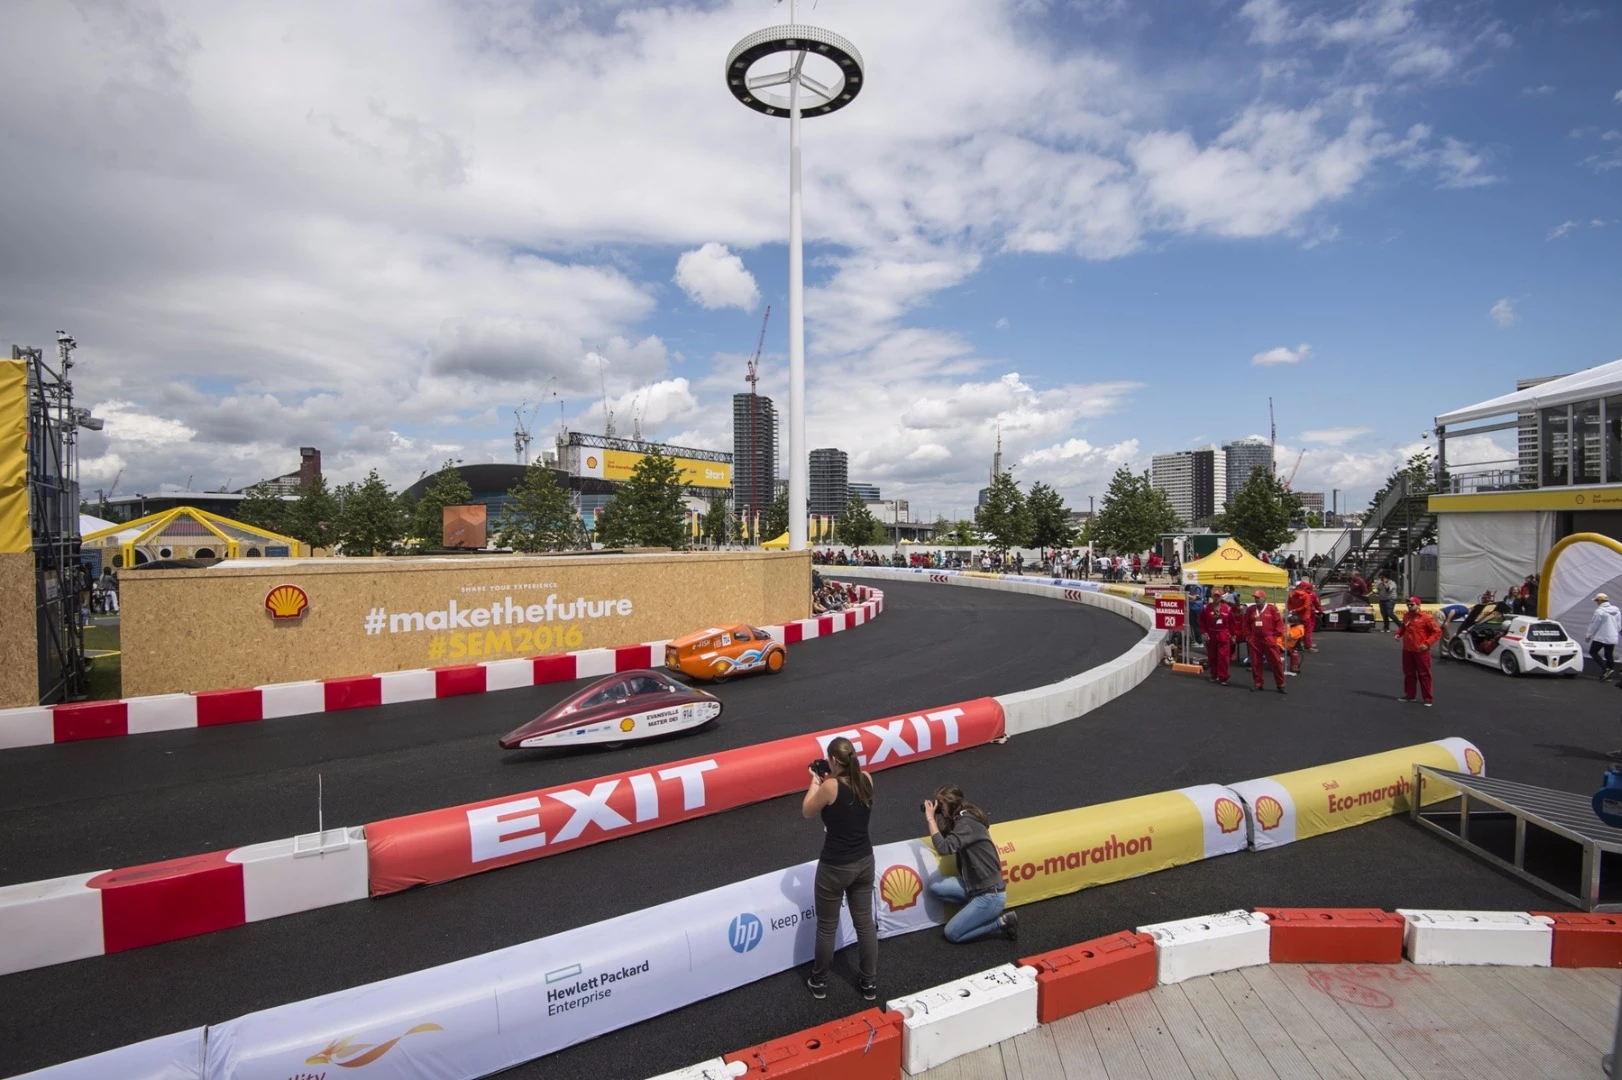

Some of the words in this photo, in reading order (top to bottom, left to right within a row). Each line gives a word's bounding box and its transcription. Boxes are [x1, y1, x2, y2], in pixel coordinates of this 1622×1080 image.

[705, 468, 724, 480] Start
[514, 582, 557, 590] EXPERIENCE
[364, 594, 633, 636] #makethefuture
[1164, 616, 1176, 627] 20
[427, 624, 584, 660] #SEM2016
[646, 709, 679, 720] EVANSVILLE
[648, 717, 668, 727] MATER
[816, 707, 965, 767] EXIT
[1322, 779, 1340, 791] Shell
[1328, 776, 1427, 814] Eco-marathn
[466, 759, 719, 863] EXIT
[997, 841, 1016, 856] hell
[732, 913, 761, 953] hp
[770, 913, 799, 931] keep
[547, 977, 599, 1003] Hewlett
[600, 960, 650, 986] Packard
[548, 988, 612, 1017] Enterprise
